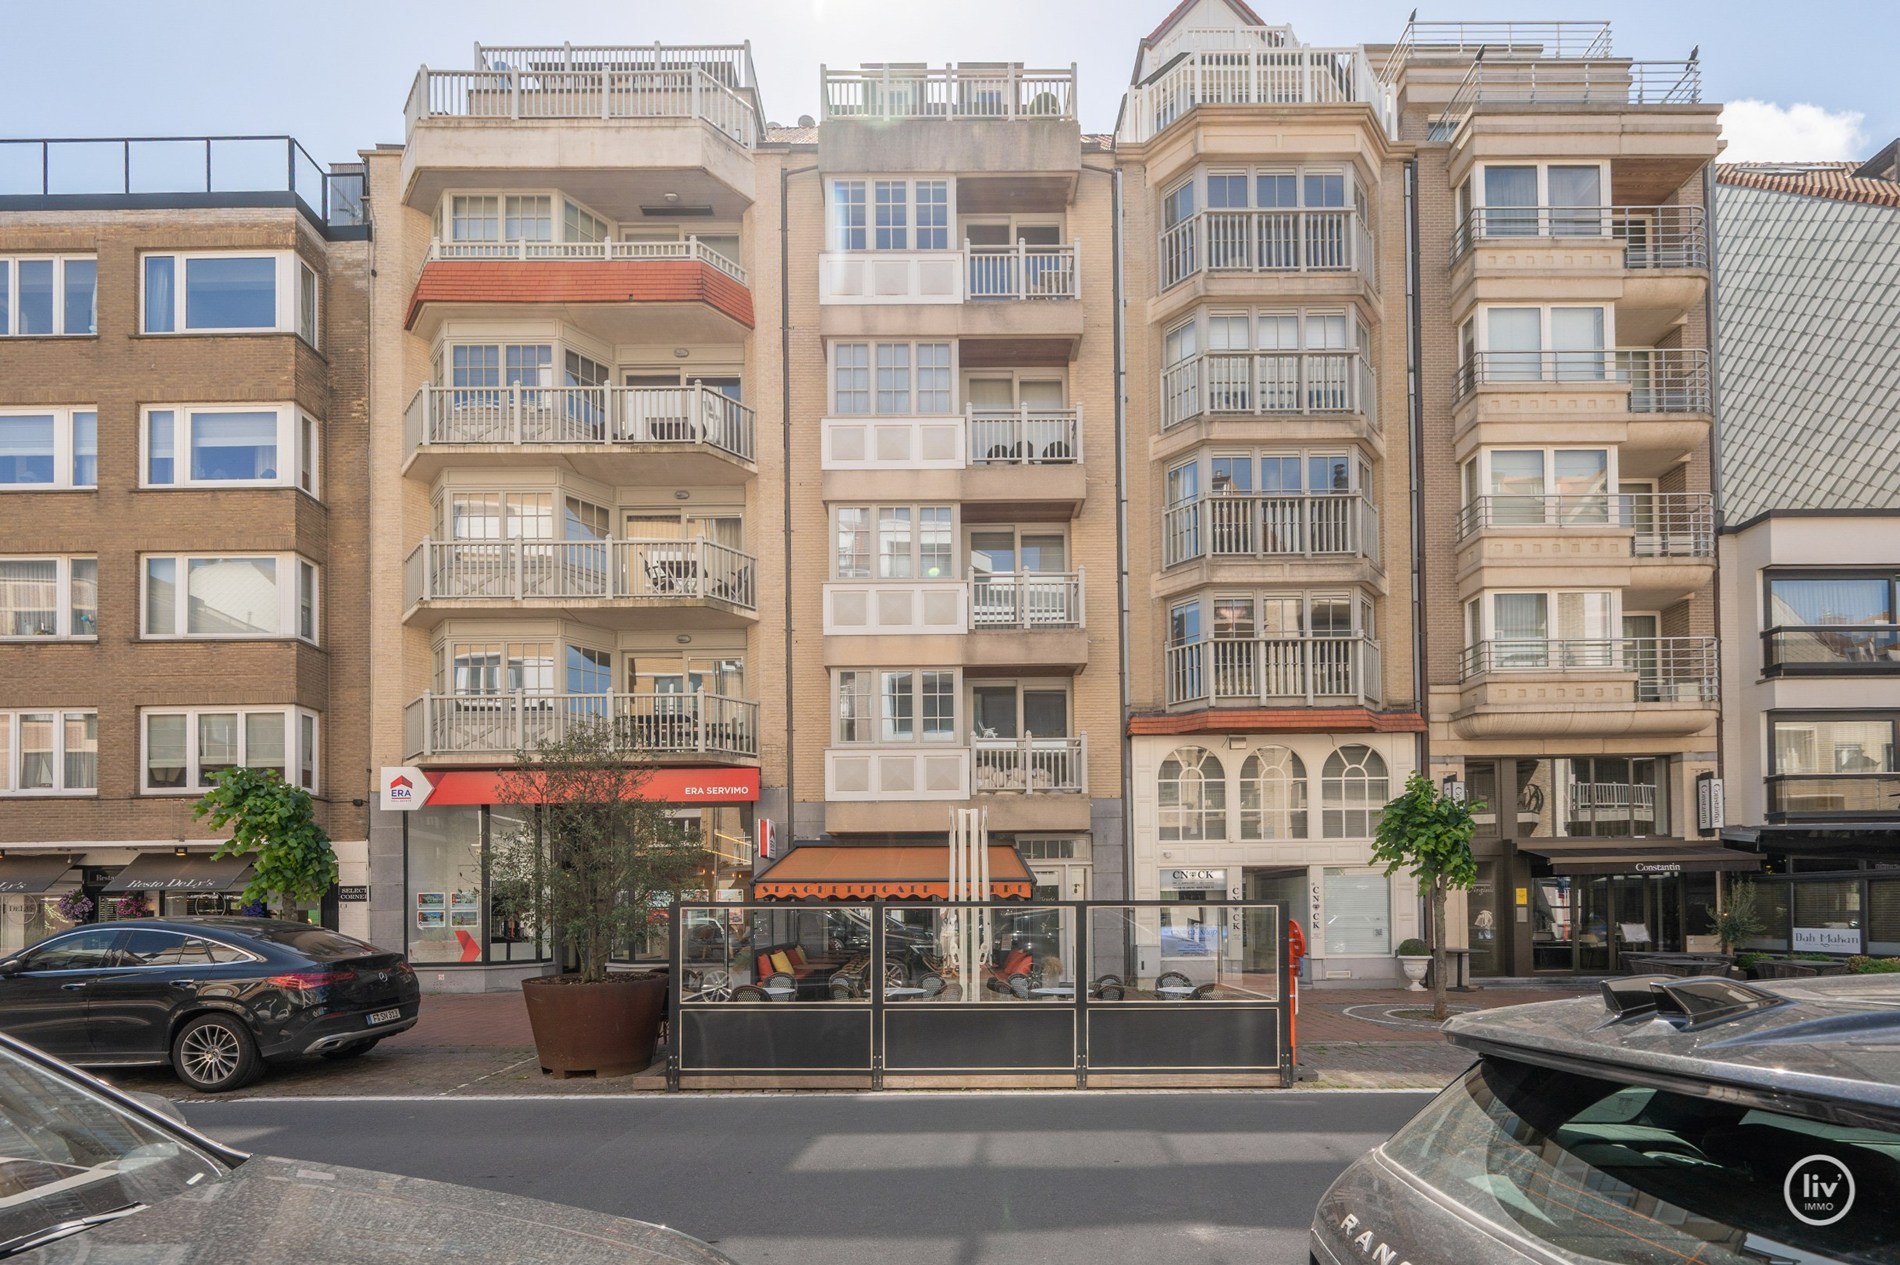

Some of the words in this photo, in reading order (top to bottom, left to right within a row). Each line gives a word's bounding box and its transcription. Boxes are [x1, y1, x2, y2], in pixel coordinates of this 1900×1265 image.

[391, 789, 412, 797] ERA
[684, 787, 704, 795] ERA
[706, 786, 749, 795] SERVIMO
[1635, 862, 1681, 872] Constantin
[126, 879, 163, 888] Resto
[1340, 1213, 1413, 1265] RAN
